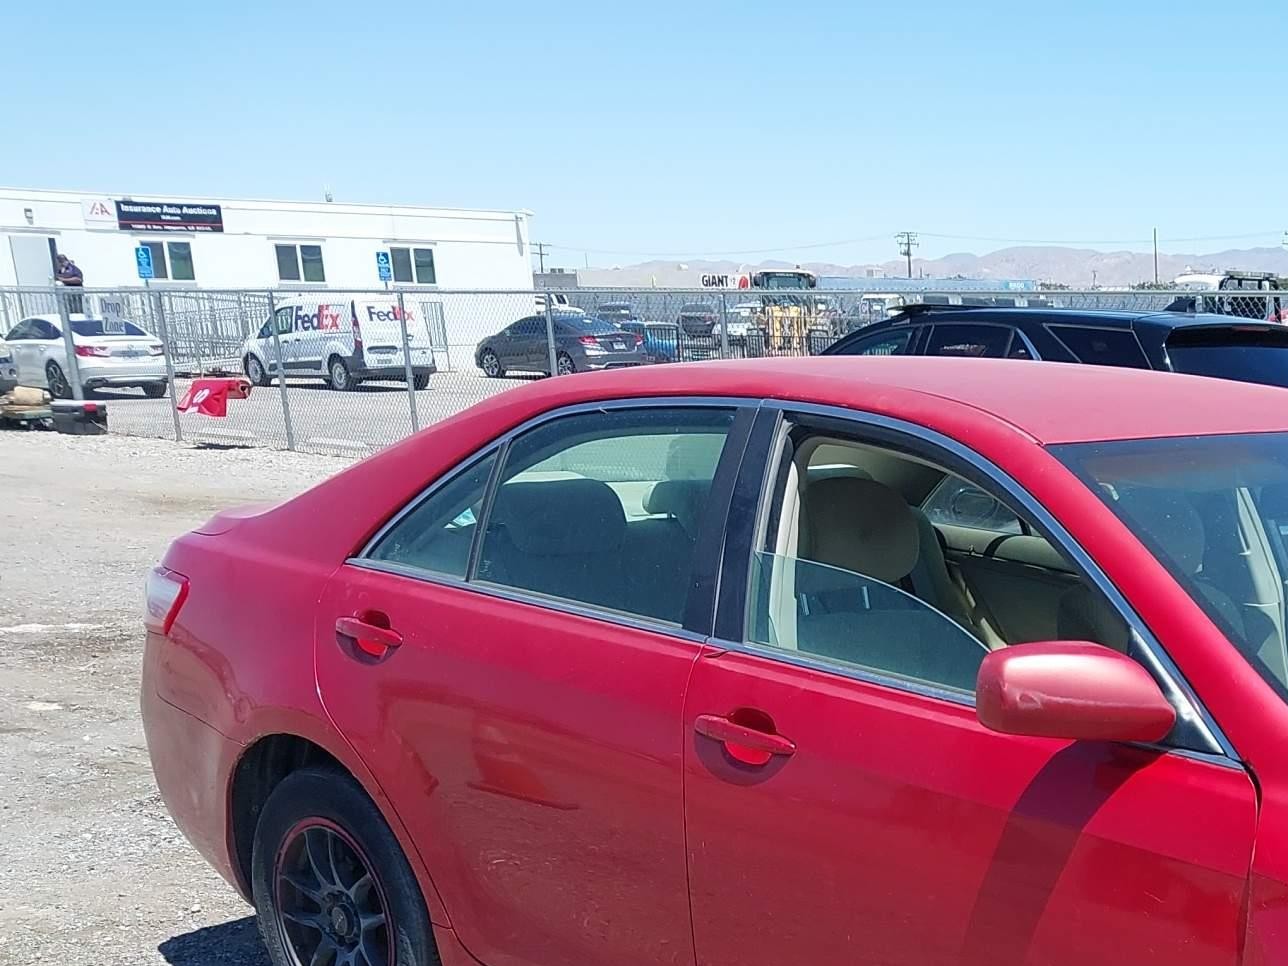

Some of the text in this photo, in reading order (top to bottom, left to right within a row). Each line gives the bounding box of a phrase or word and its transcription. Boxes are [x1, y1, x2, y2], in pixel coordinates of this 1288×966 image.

[120, 203, 217, 216] Insurance Auto Auctions
[701, 274, 729, 288] GIANT
[100, 298, 121, 318] Drop
[367, 305, 415, 323] FedEx
[104, 316, 125, 333] Zone
[295, 304, 340, 331] FedEx
